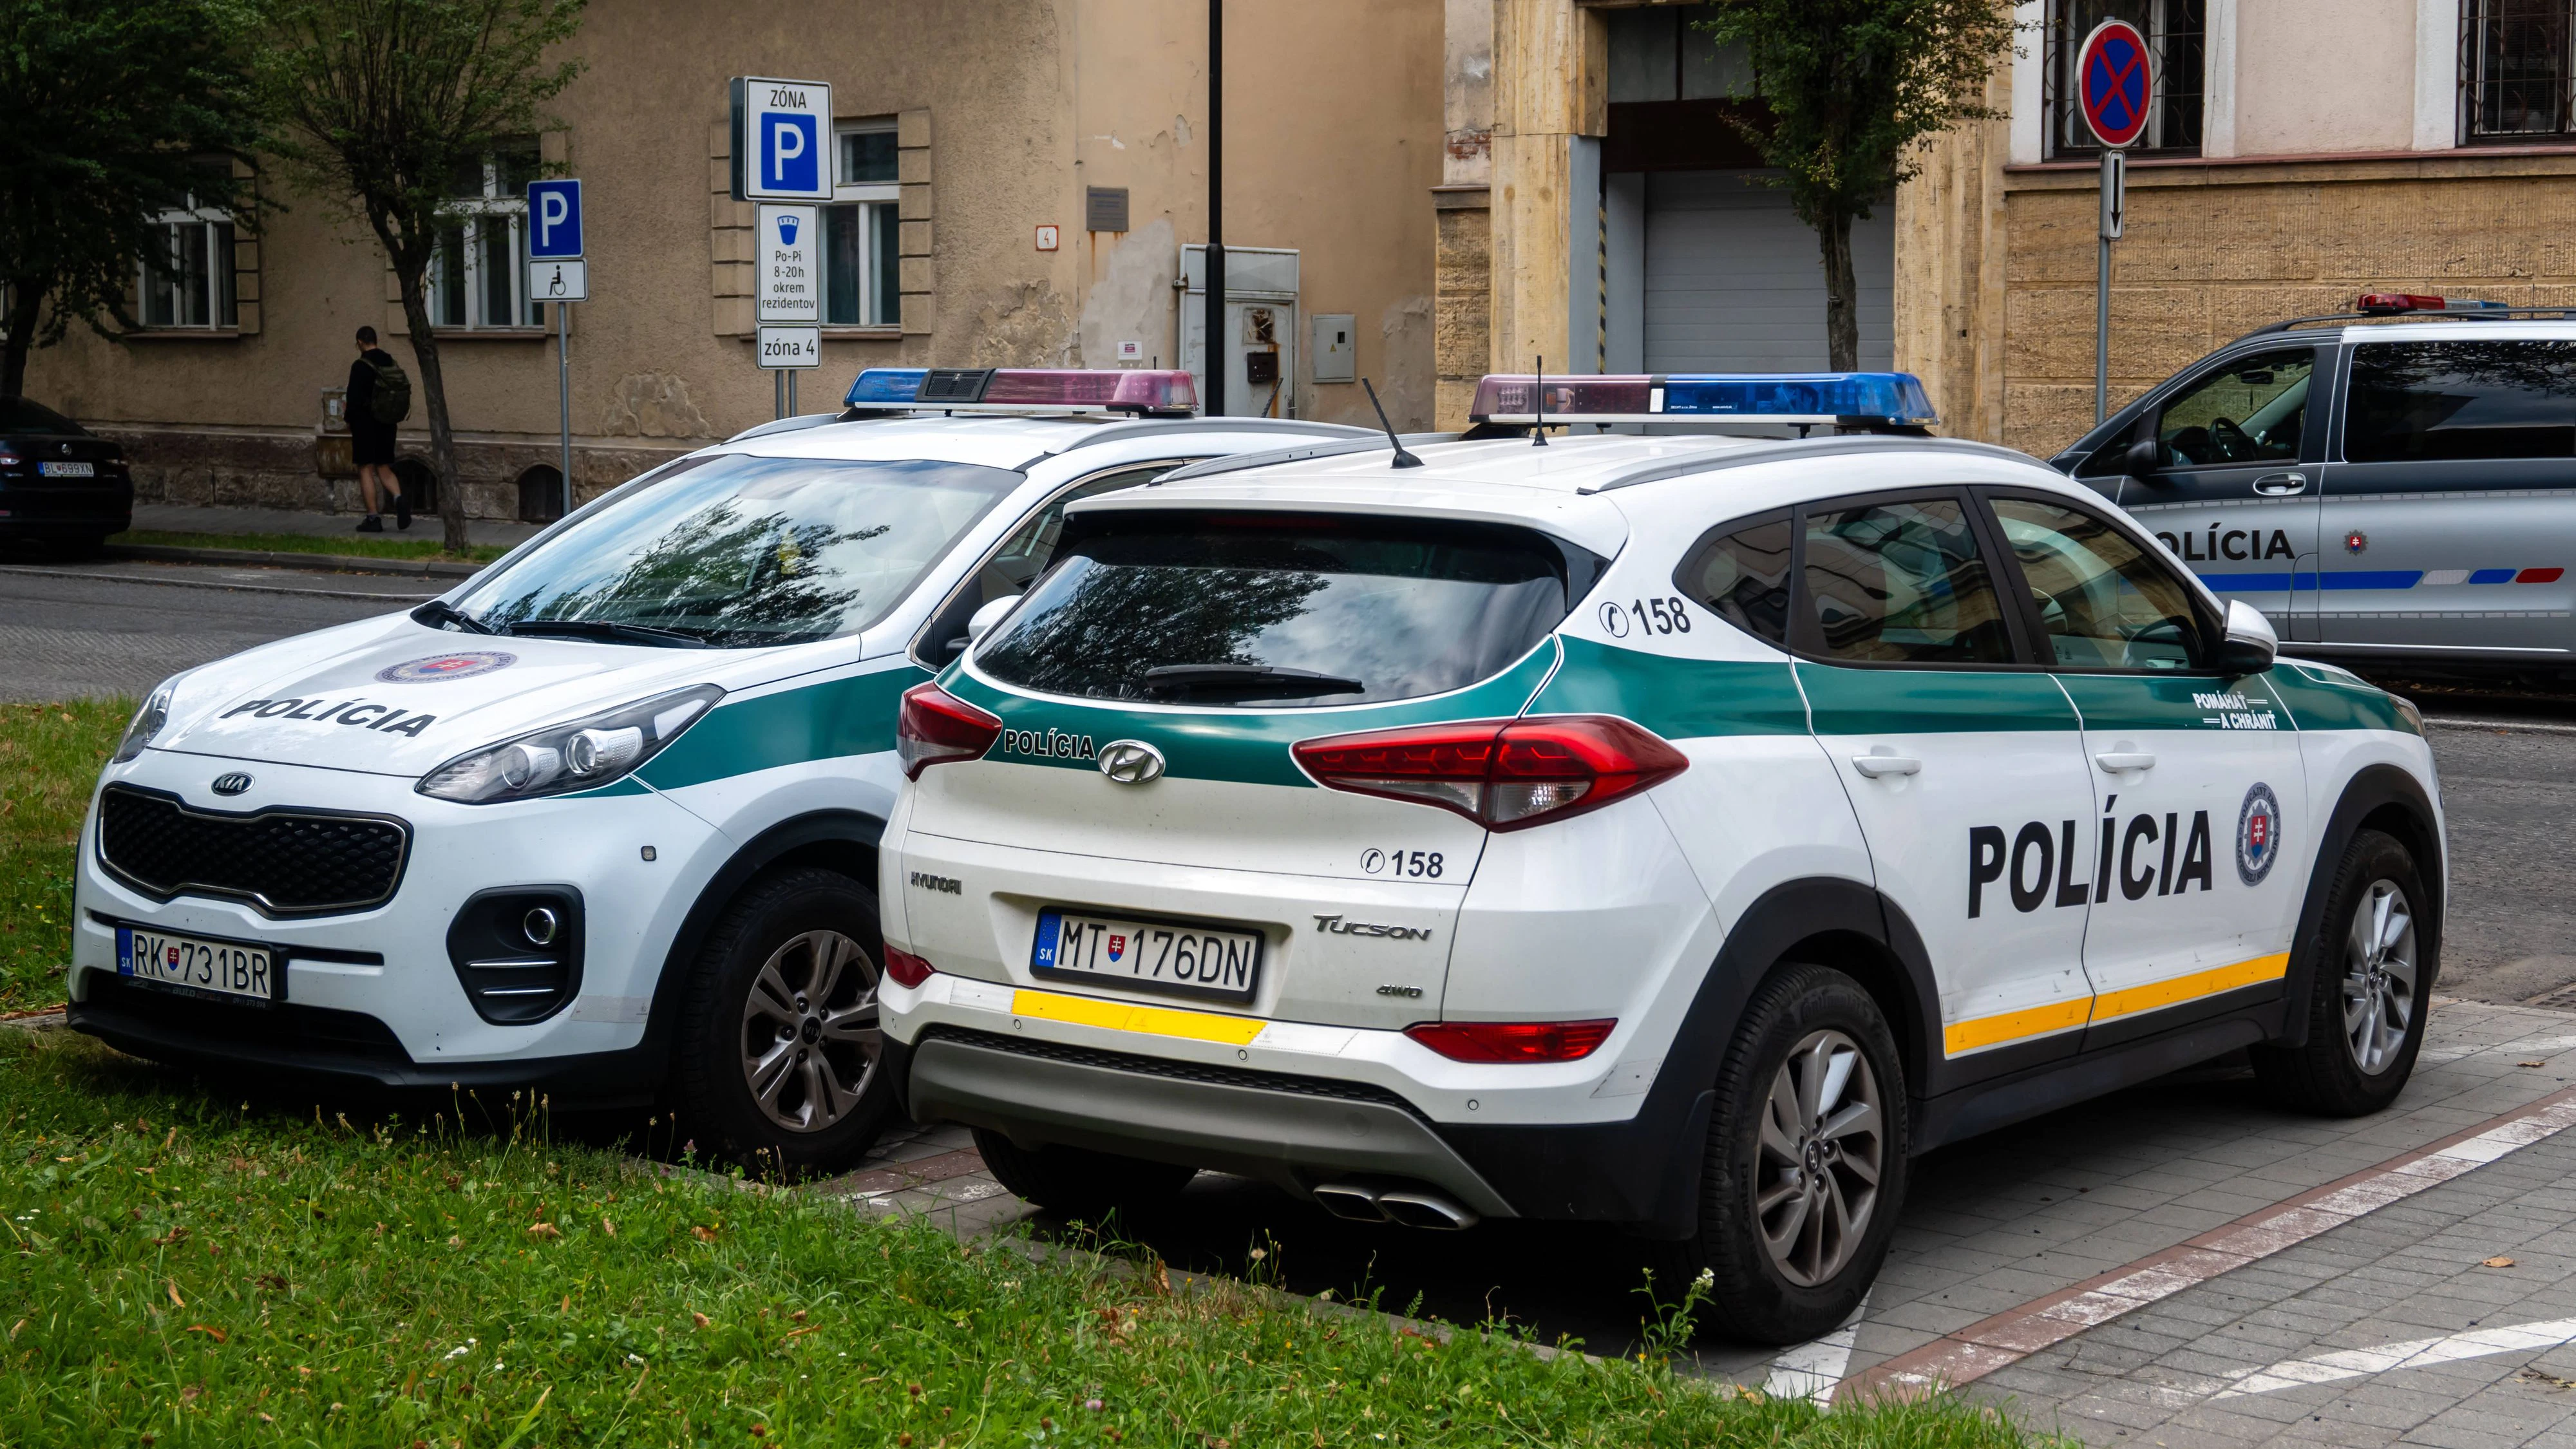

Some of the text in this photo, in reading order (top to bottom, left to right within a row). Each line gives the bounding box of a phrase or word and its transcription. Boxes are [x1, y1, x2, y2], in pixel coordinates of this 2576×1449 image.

[770, 86, 806, 108] ZÓNA
[775, 122, 804, 180] P
[540, 191, 568, 247] P
[775, 251, 801, 261] Po-Pi
[773, 281, 804, 293] okrem
[762, 296, 815, 308] rezidentov
[764, 338, 815, 355] zóna 4
[44, 463, 93, 473] BL 699XN
[2154, 522, 2295, 561] OLÍCIA
[1632, 597, 1690, 635] 158
[2192, 690, 2248, 709] POMÁHAŤ
[219, 697, 437, 737] POLÍCIA
[2221, 710, 2277, 729] A CHRÁNIŤ
[1005, 728, 1095, 760] POLÍCIA
[214, 775, 247, 790] KIA
[1392, 850, 1443, 878] 158
[1968, 794, 2212, 919] POLÍCIA
[911, 871, 961, 895] HYUNDAI
[121, 934, 269, 994] SK RK 731BR
[1039, 921, 1250, 988] SK MT 176DN
[1376, 984, 1423, 998] 4WD
[803, 1025, 820, 1037] KIA
